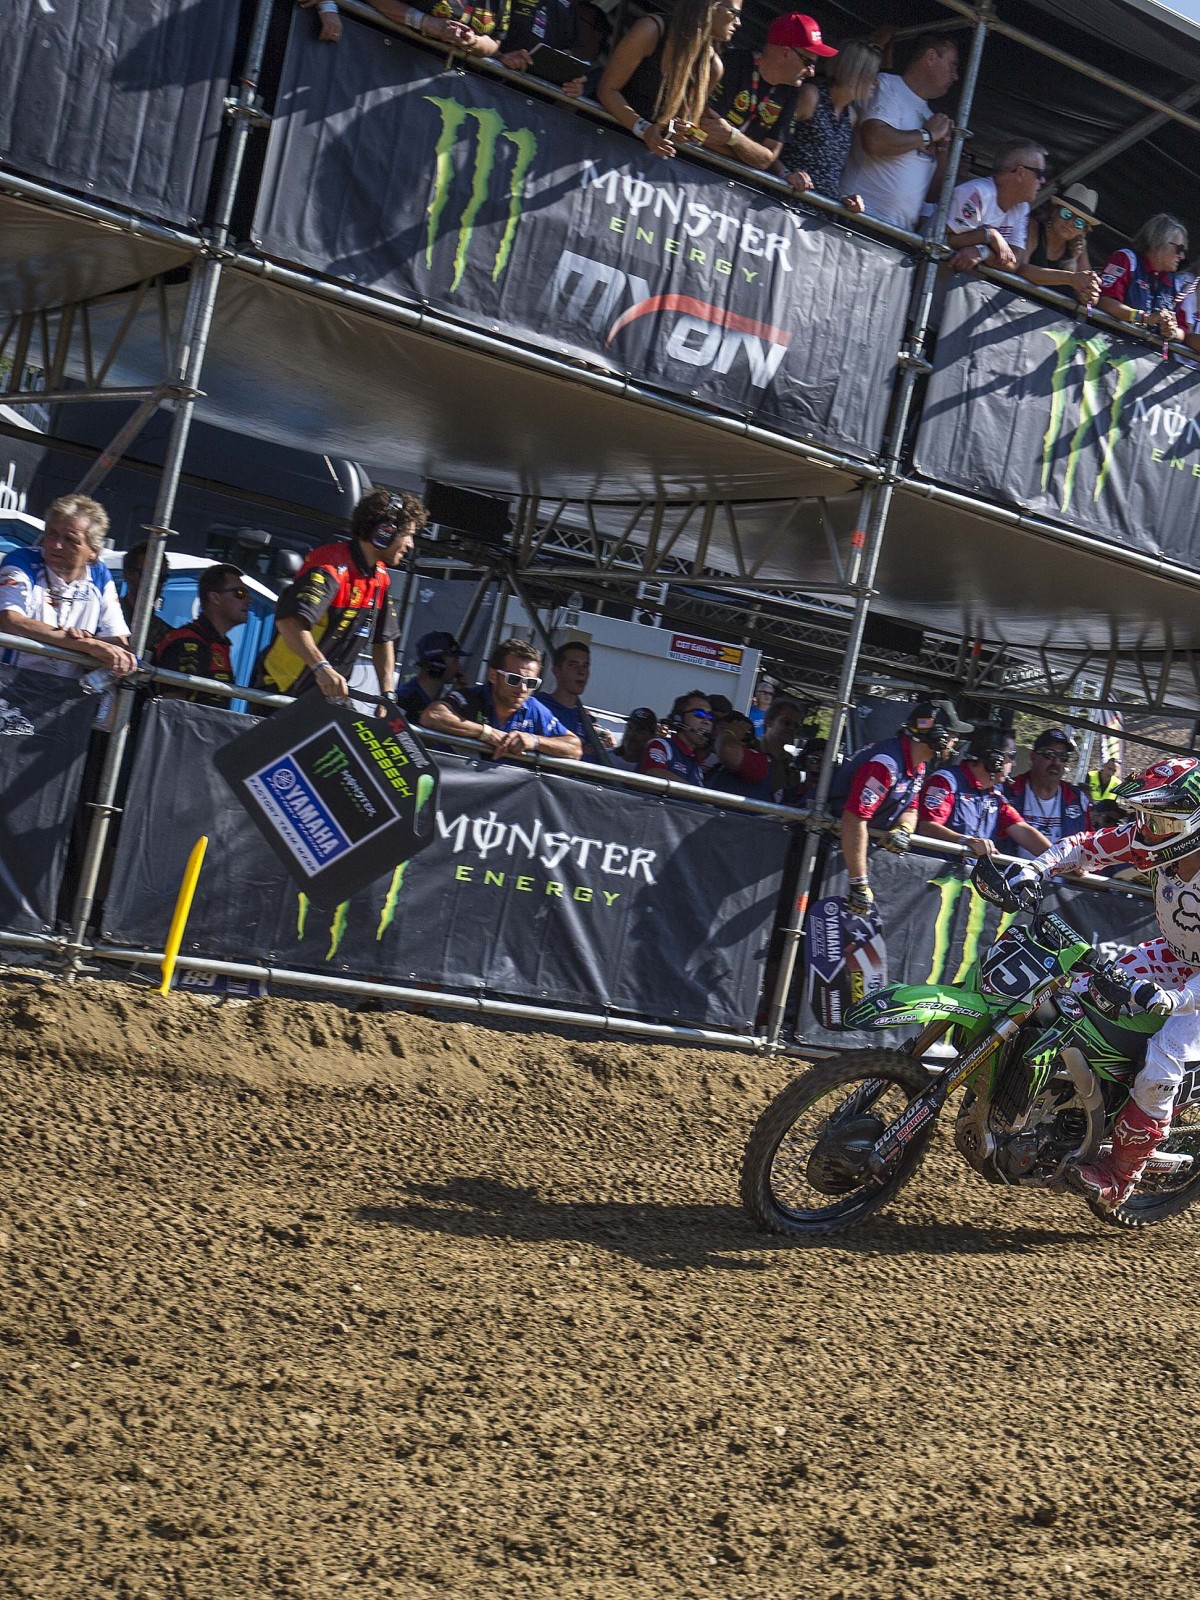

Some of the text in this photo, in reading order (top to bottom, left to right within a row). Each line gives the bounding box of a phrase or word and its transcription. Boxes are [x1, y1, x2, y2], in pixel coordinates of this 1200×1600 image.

[581, 159, 793, 271] MONSTER
[609, 217, 758, 282] ENERGY
[352, 720, 413, 798] HOREBEEK
[382, 736, 409, 767] VAN
[249, 778, 279, 818] FACTORY
[278, 819, 297, 845] TEAM
[341, 769, 377, 818] MONSTER
[286, 783, 339, 855] YAMAHA
[436, 810, 657, 885] MONSTER
[455, 865, 621, 907] ENERGY
[825, 916, 841, 962] YAMAHA
[1047, 914, 1082, 943] RENTH
[915, 1001, 942, 1011] PRO
[948, 1035, 993, 1083] RO CIRCUIT
[1157, 1084, 1175, 1092] FOX
[874, 1098, 924, 1152] DUNLOP
[897, 1106, 930, 1140] BRAKING
[912, 1113, 934, 1134] PISTONS
[1146, 1161, 1174, 1169] ENTHAL
